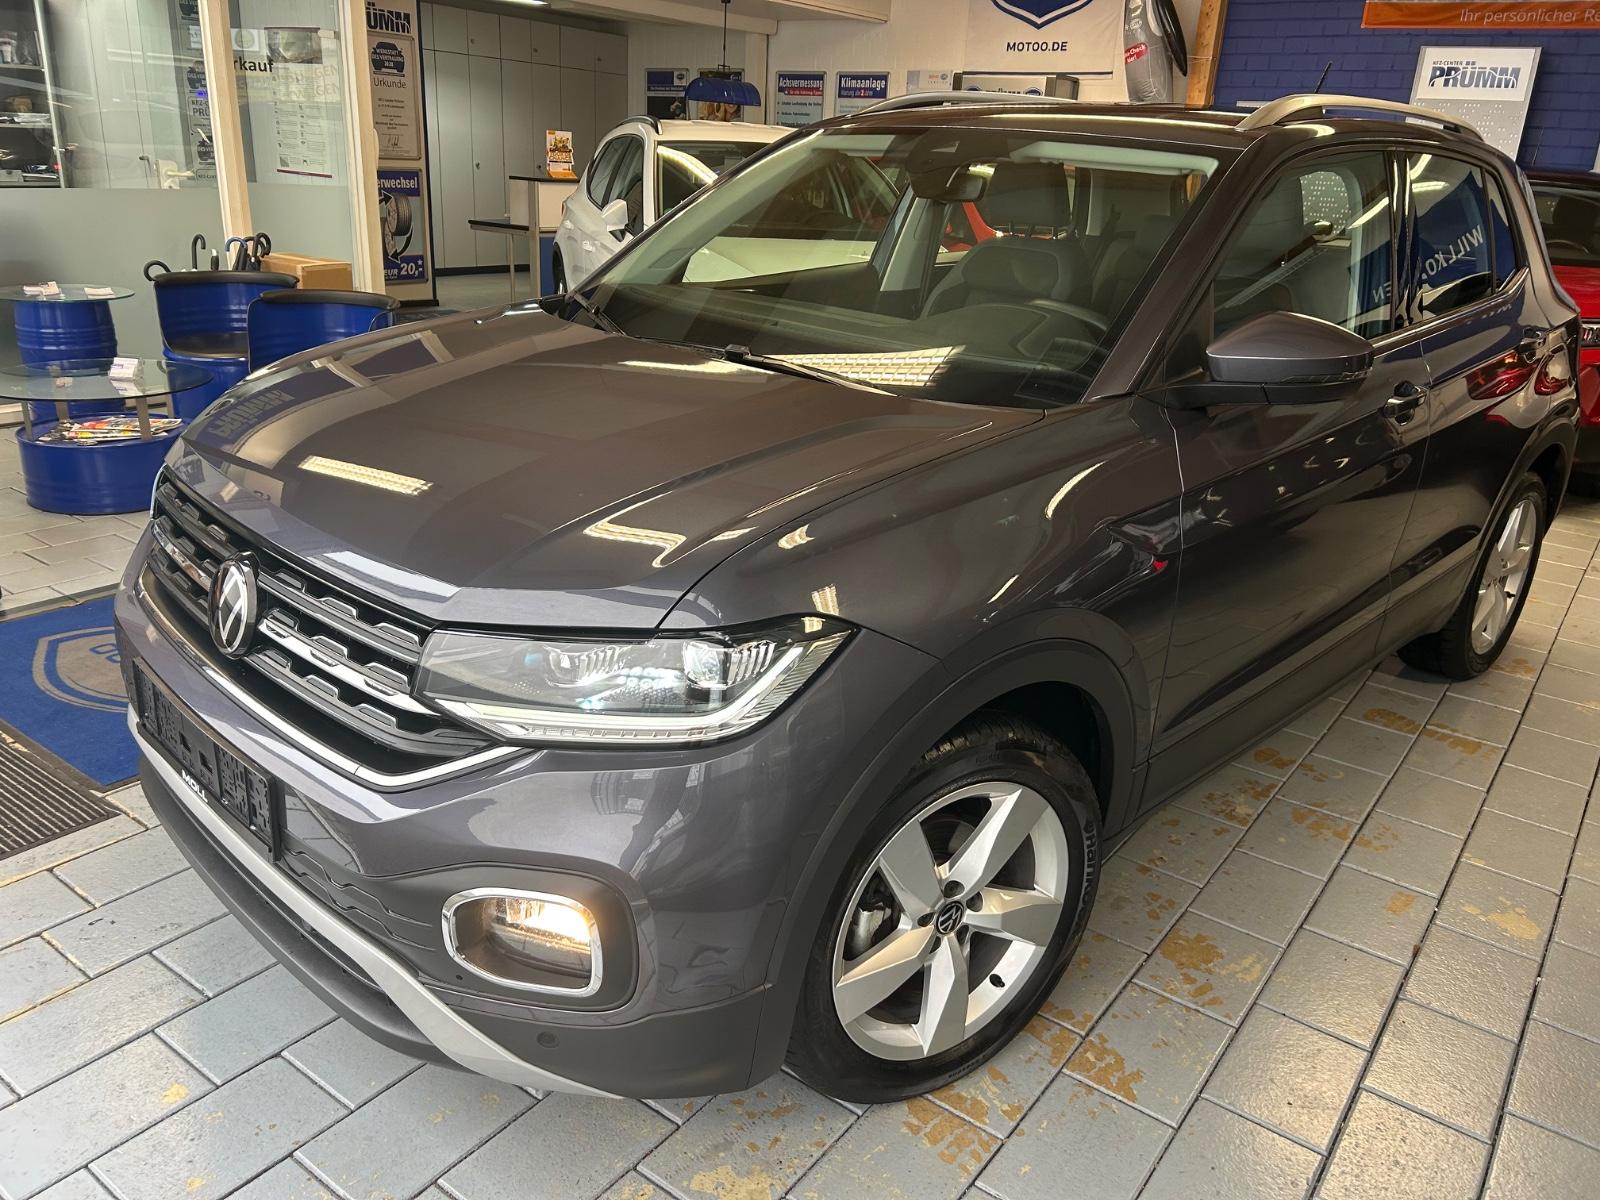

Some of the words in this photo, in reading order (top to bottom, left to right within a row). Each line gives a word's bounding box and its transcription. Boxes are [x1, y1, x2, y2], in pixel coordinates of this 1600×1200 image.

[1460, 9, 1481, 22] Ihr
[1483, 8, 1579, 25] persönlicher
[1006, 41, 1068, 52] MOTOO.DE
[373, 78, 407, 89] Urkunde
[779, 77, 823, 90] Achsvermessung
[841, 77, 886, 91] Klimaanlage
[1428, 66, 1521, 89] PRÜMM
